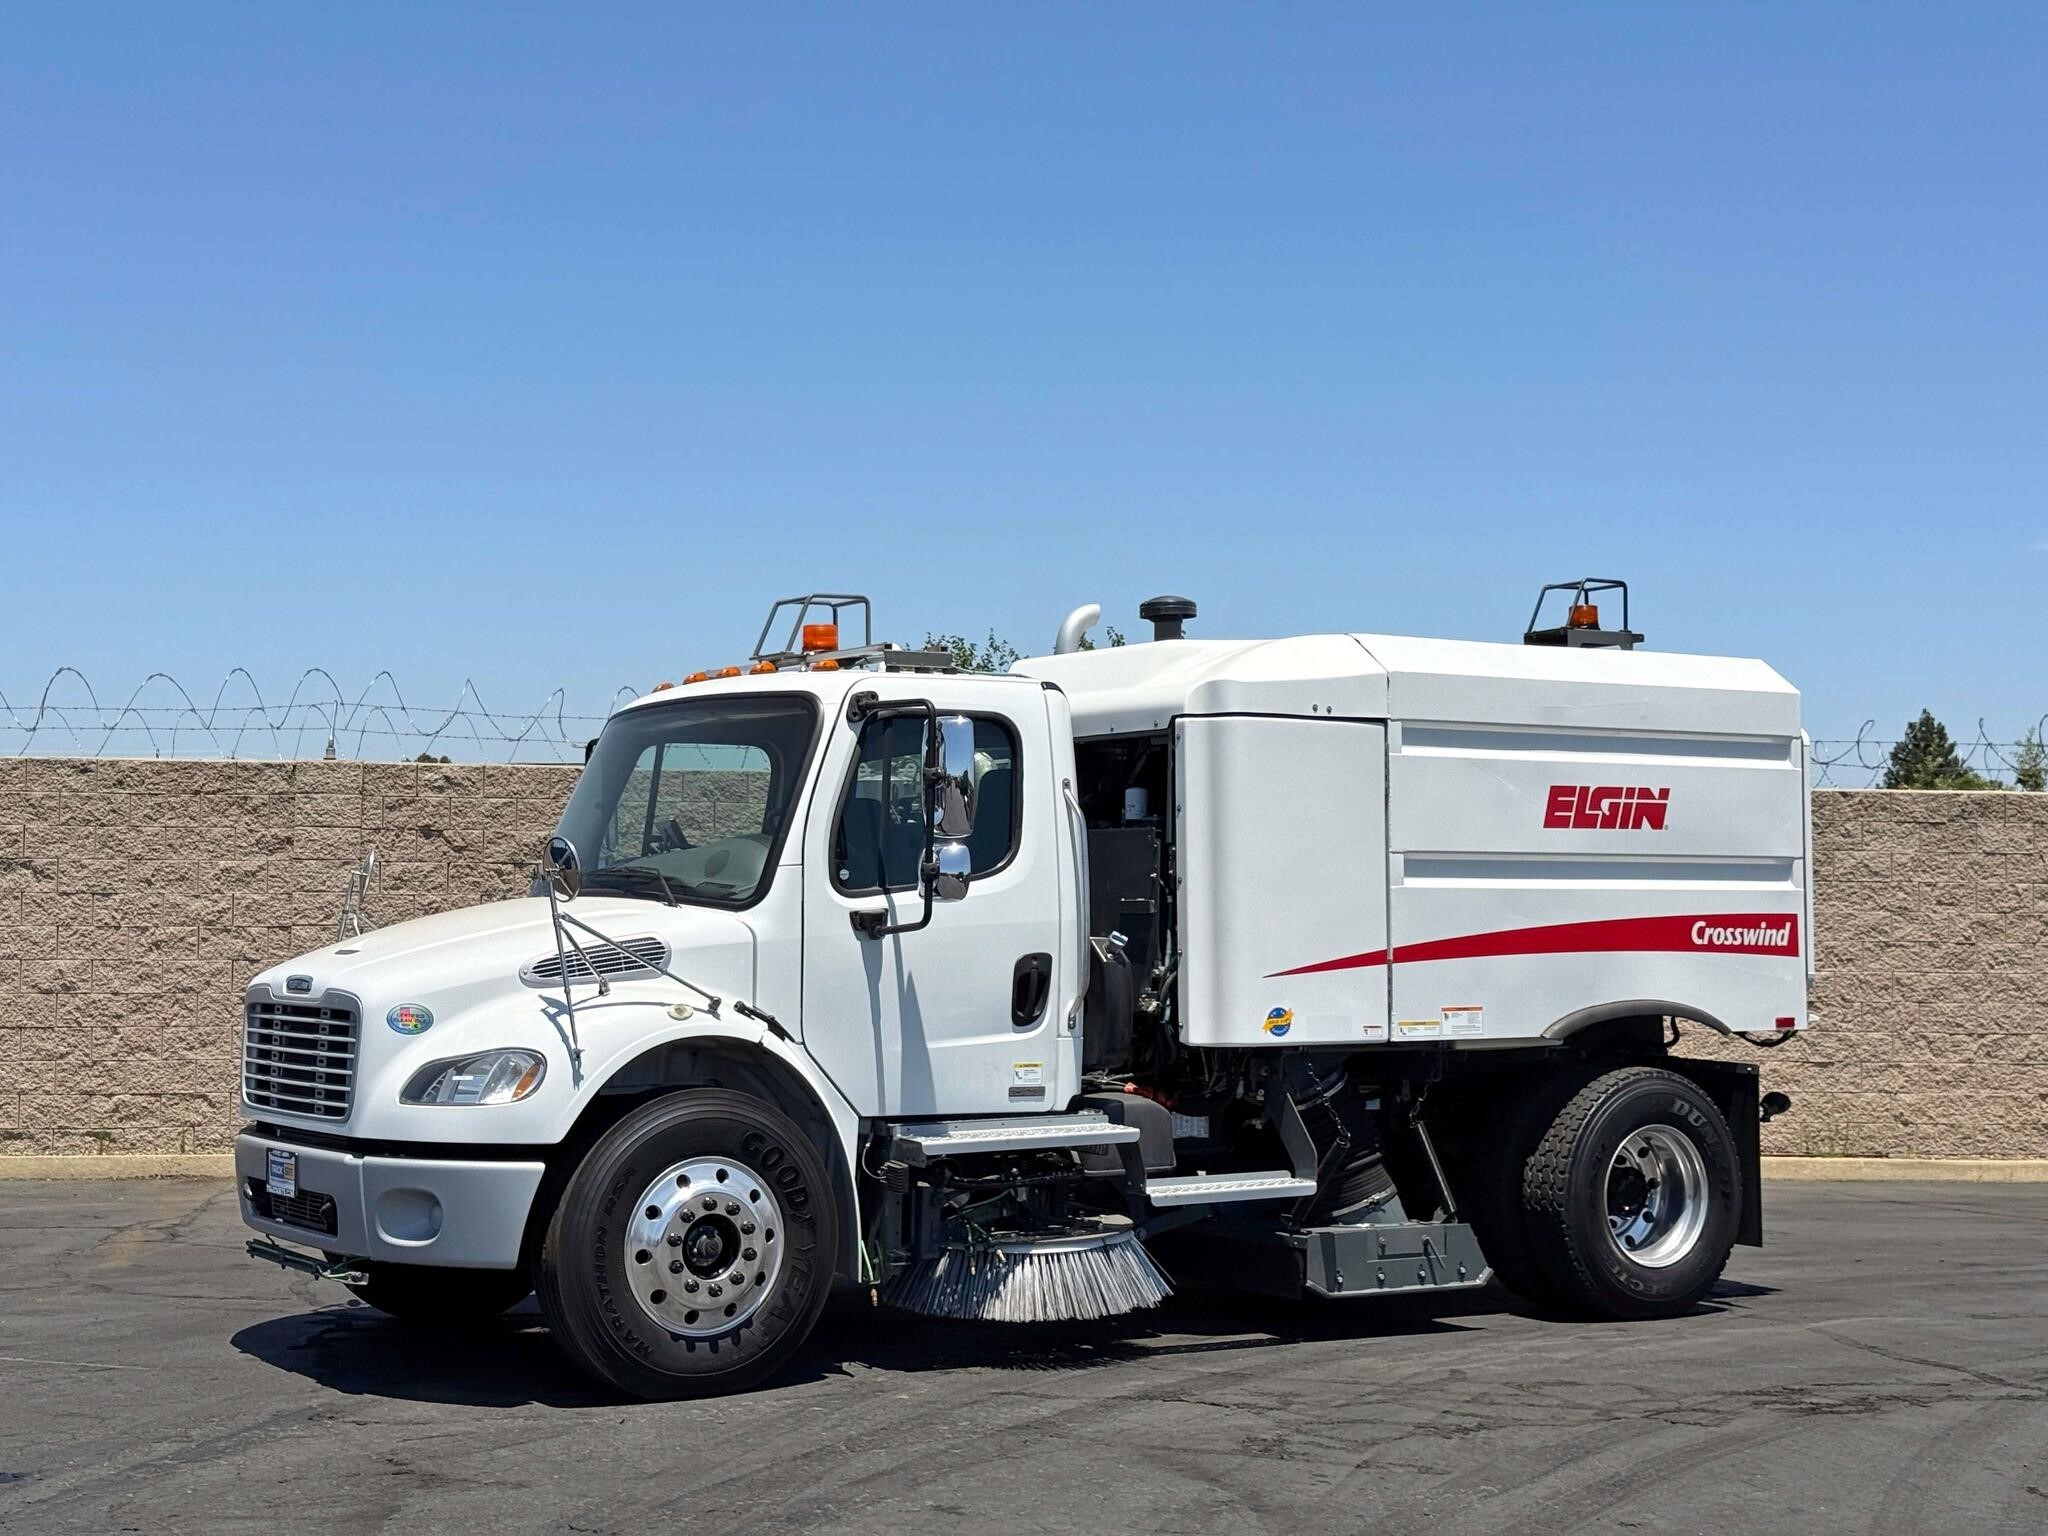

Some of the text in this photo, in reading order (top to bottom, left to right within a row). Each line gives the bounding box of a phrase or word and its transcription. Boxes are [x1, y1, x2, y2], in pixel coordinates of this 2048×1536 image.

[1543, 785, 1670, 830] ELGIN
[1691, 920, 1792, 947] Crosswind
[742, 1131, 817, 1349] GOODYEAR
[594, 1225, 656, 1360] MARATHON
